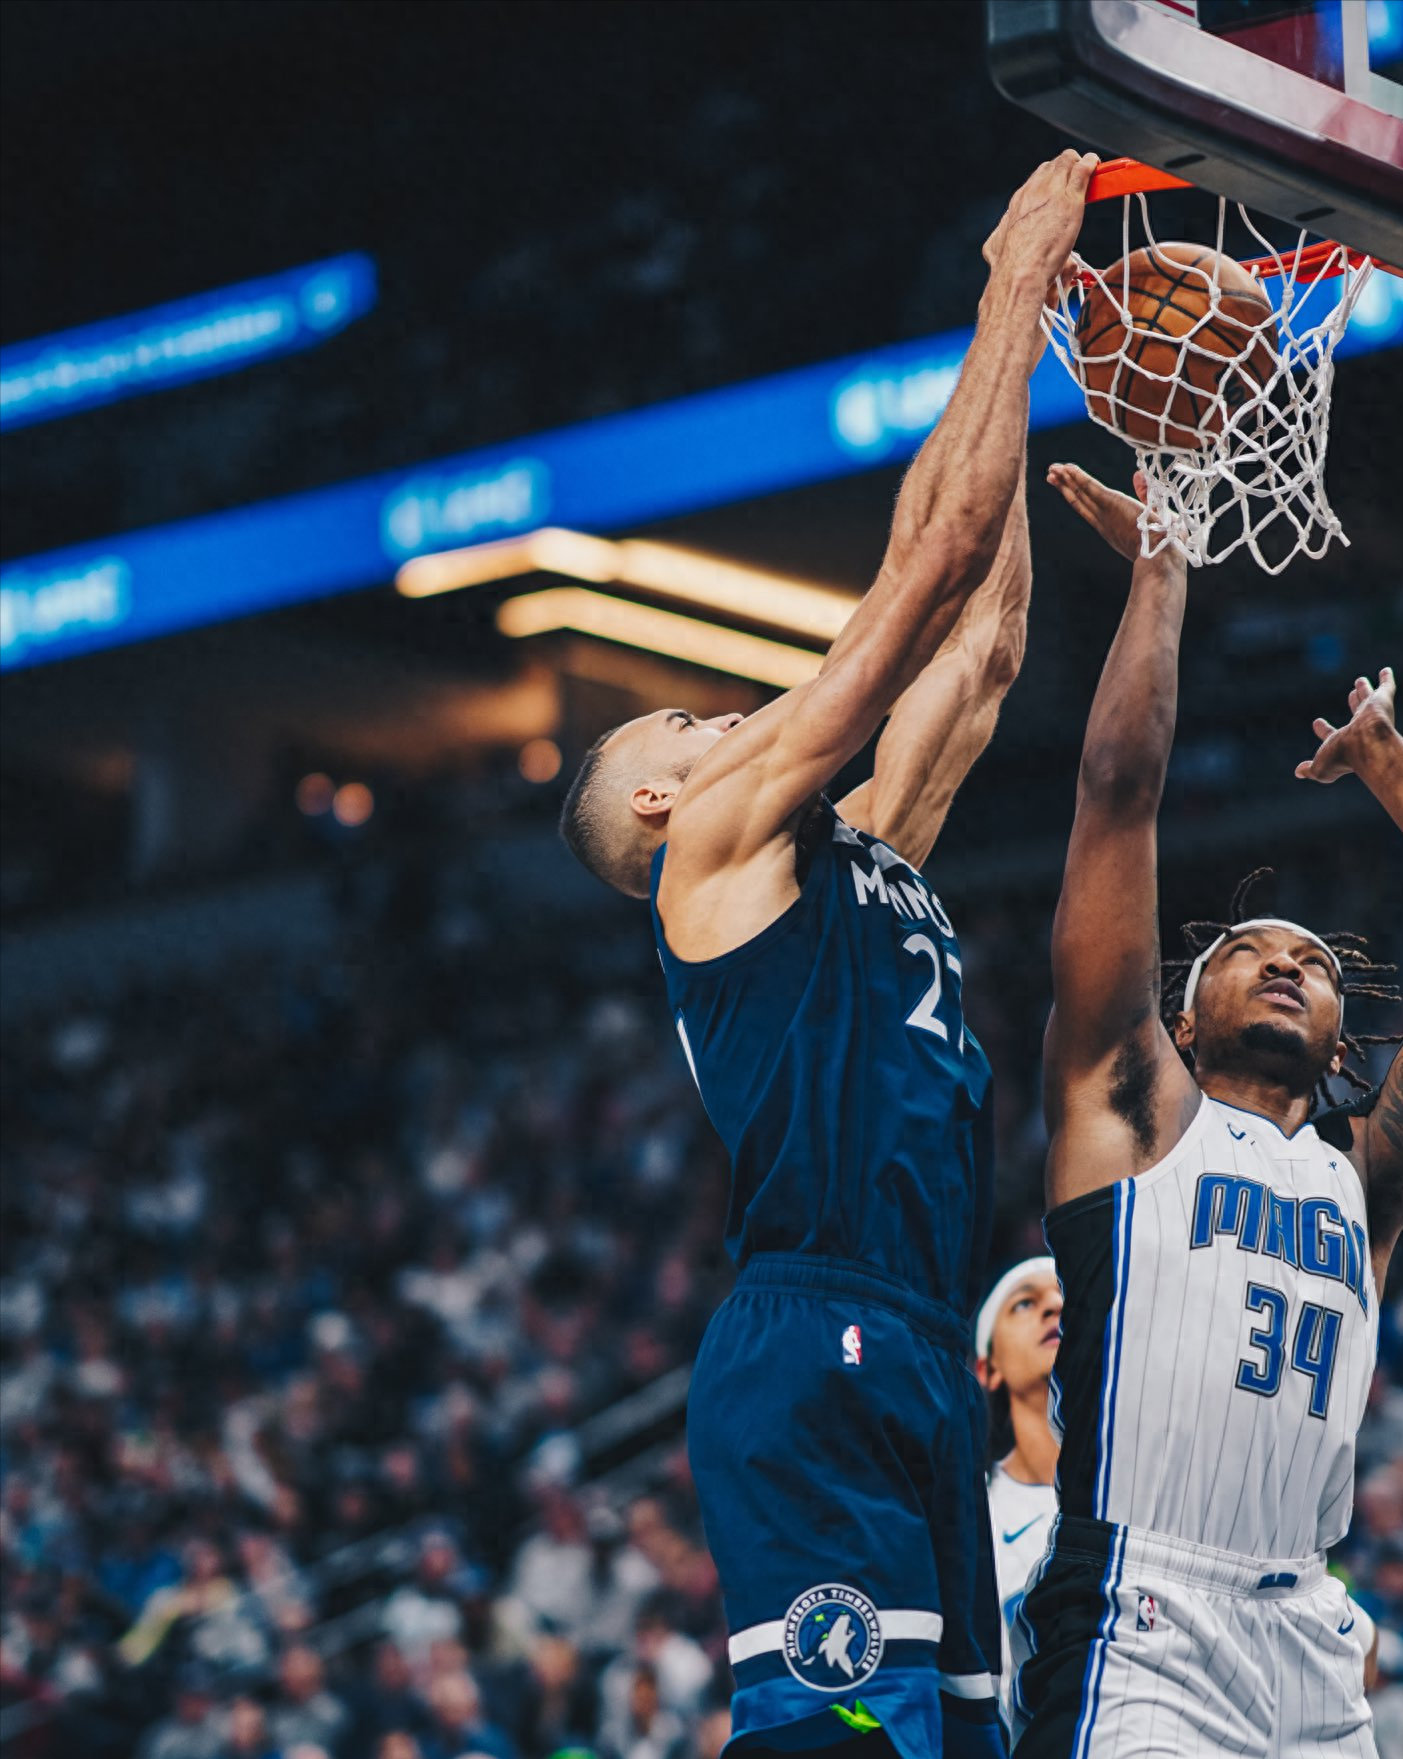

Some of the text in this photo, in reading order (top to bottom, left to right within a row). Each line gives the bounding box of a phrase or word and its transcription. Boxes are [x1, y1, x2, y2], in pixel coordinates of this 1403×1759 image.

[1235, 1281, 1343, 1420] 34
[786, 1589, 880, 1671] MINNESOTA TIMBERWOLVES
